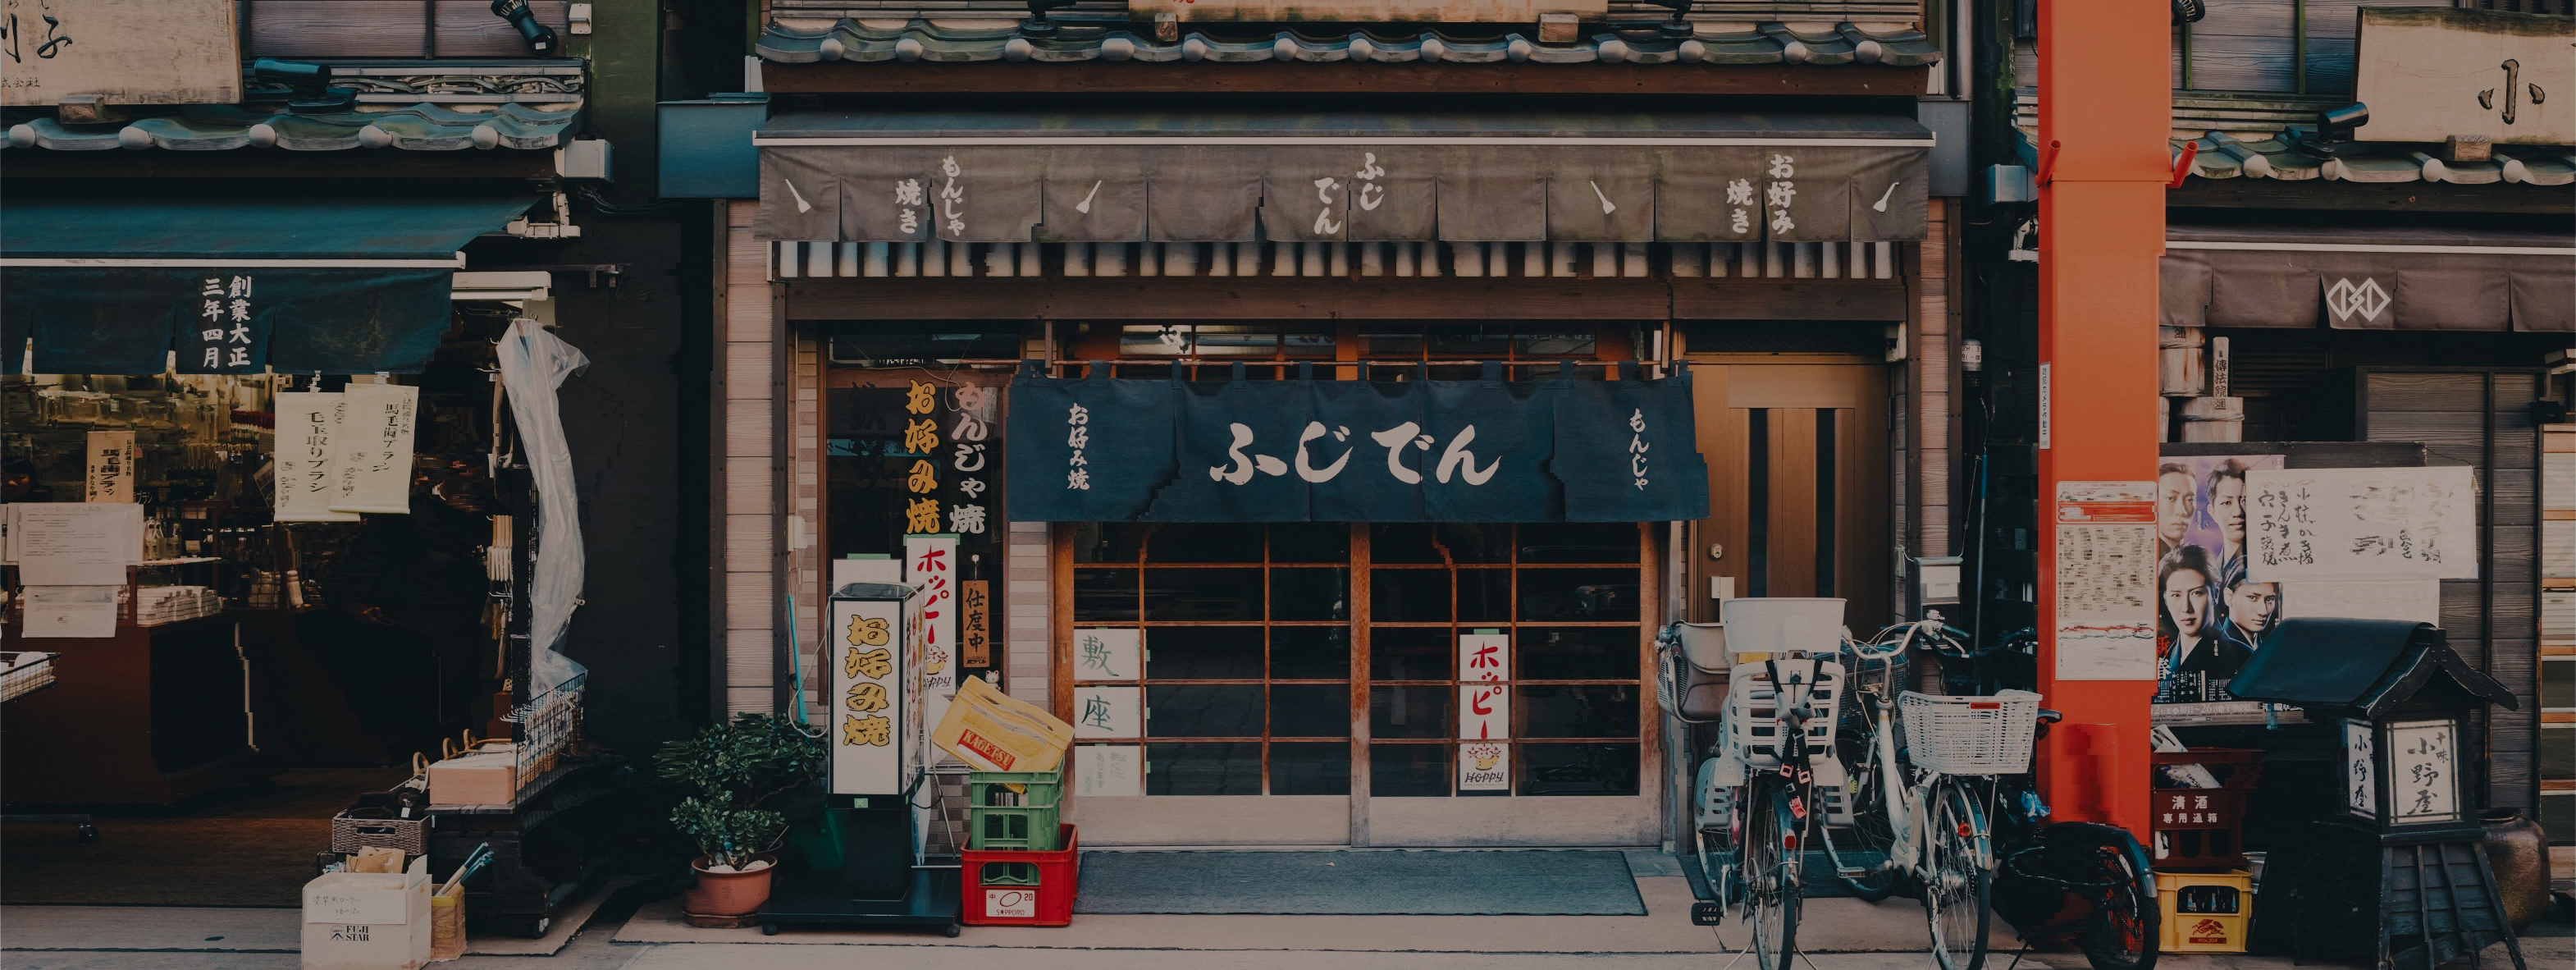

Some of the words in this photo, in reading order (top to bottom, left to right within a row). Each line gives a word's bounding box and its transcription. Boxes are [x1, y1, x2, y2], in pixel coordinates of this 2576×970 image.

[2478, 58, 2545, 125] 小
[895, 178, 922, 234] 焼き
[941, 155, 966, 236] もんじゃ
[1313, 176, 1341, 235] でん
[1356, 152, 1386, 211] ふじ
[1726, 178, 1754, 234] 焼き
[1767, 153, 1797, 235] お好み
[202, 277, 225, 369] 三年四月
[228, 275, 252, 368] 創業大正
[905, 379, 941, 534] お好み焼
[948, 381, 989, 534] もんじゃ焼
[1067, 402, 1090, 491] お好み焼
[1209, 421, 1501, 486] ふじでん
[1628, 408, 1650, 491] もんじゃ
[916, 543, 950, 645] ホッピー
[966, 588, 986, 653] 仕度中
[843, 614, 892, 748] お好み焼
[1081, 635, 1120, 677] 敷
[1081, 694, 1115, 732] 座
[1469, 640, 1503, 740] ホッピー
[962, 731, 1014, 766] KAGETSU
[2354, 734, 2368, 808] 小野屋
[2407, 737, 2440, 815] 小野屋
[2163, 812, 2217, 824] 専用通箱
[2172, 795, 2208, 809] 清酒
[346, 925, 368, 933] FUJI
[1024, 893, 1033, 901] 20
